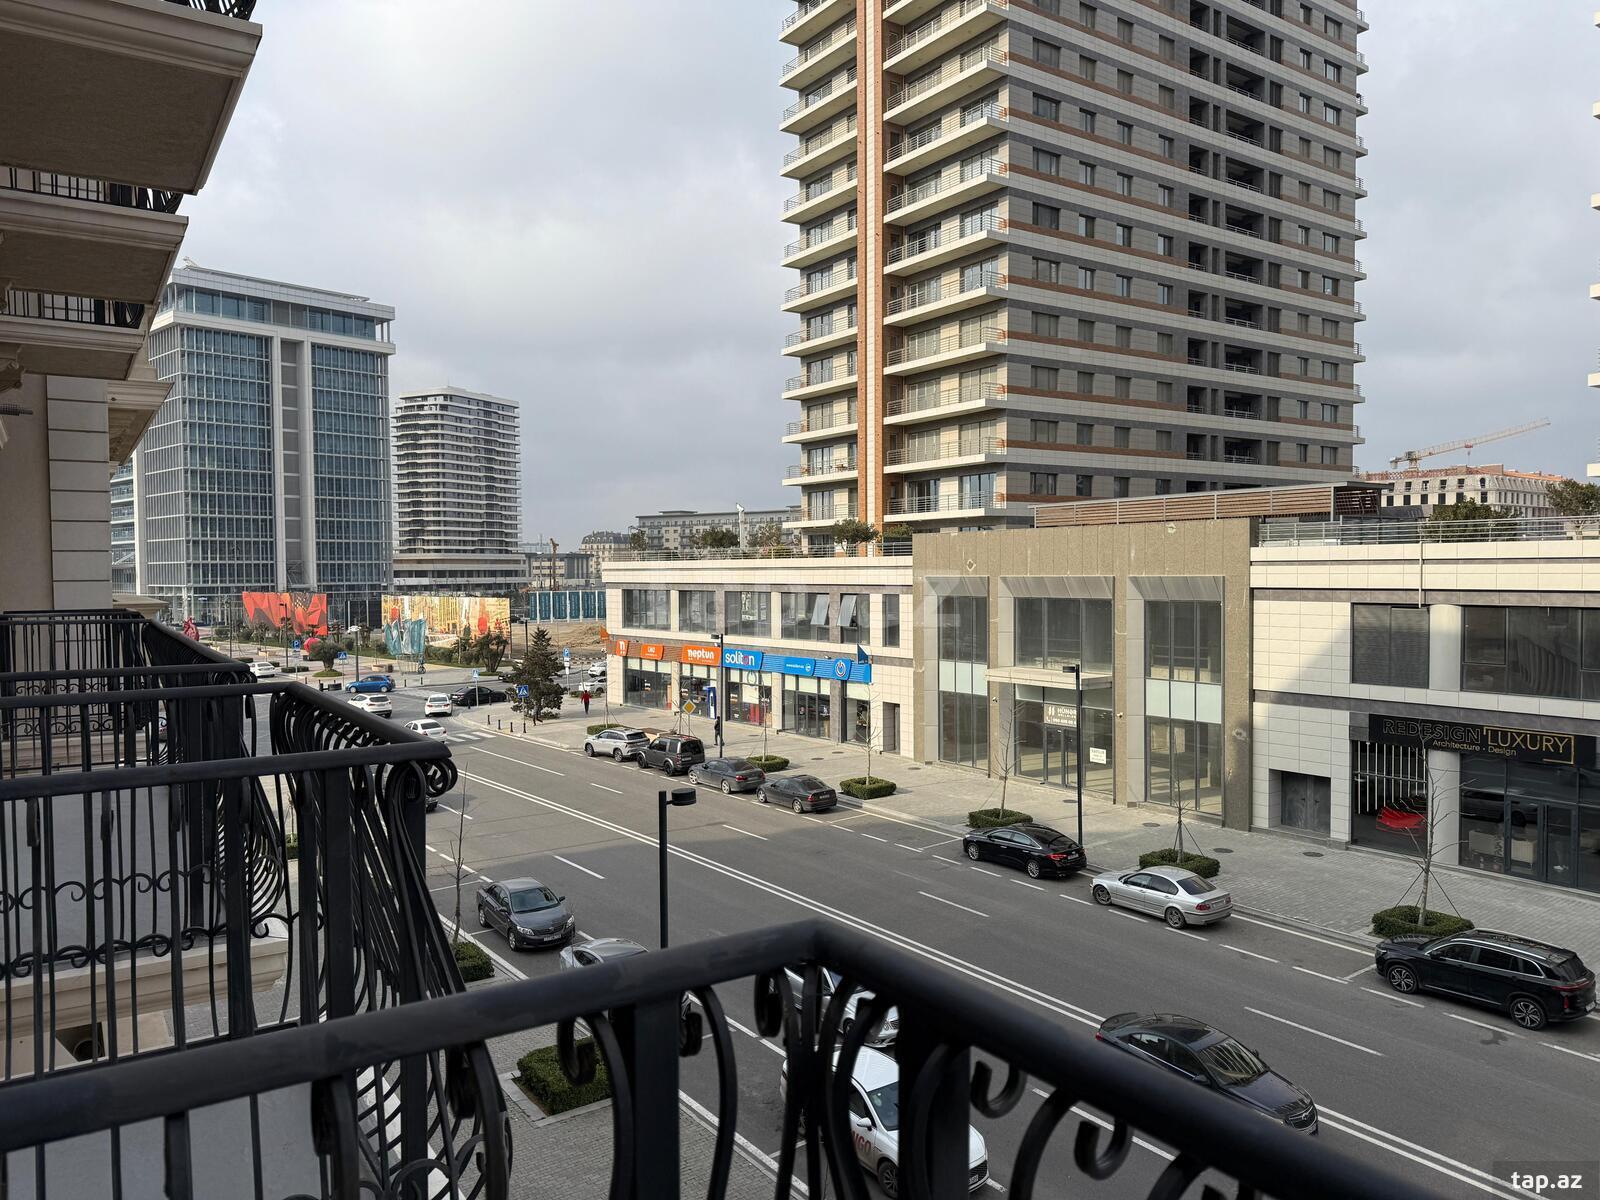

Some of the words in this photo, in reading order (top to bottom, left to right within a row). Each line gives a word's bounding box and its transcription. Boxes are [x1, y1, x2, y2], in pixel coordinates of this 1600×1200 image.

[687, 649, 714, 660] neptun
[725, 651, 755, 666] soliton
[1383, 720, 1481, 743] REDESIGN
[1488, 730, 1569, 752] LUXURY
[1433, 740, 1480, 752] Architecture
[1488, 746, 1517, 757] Design
